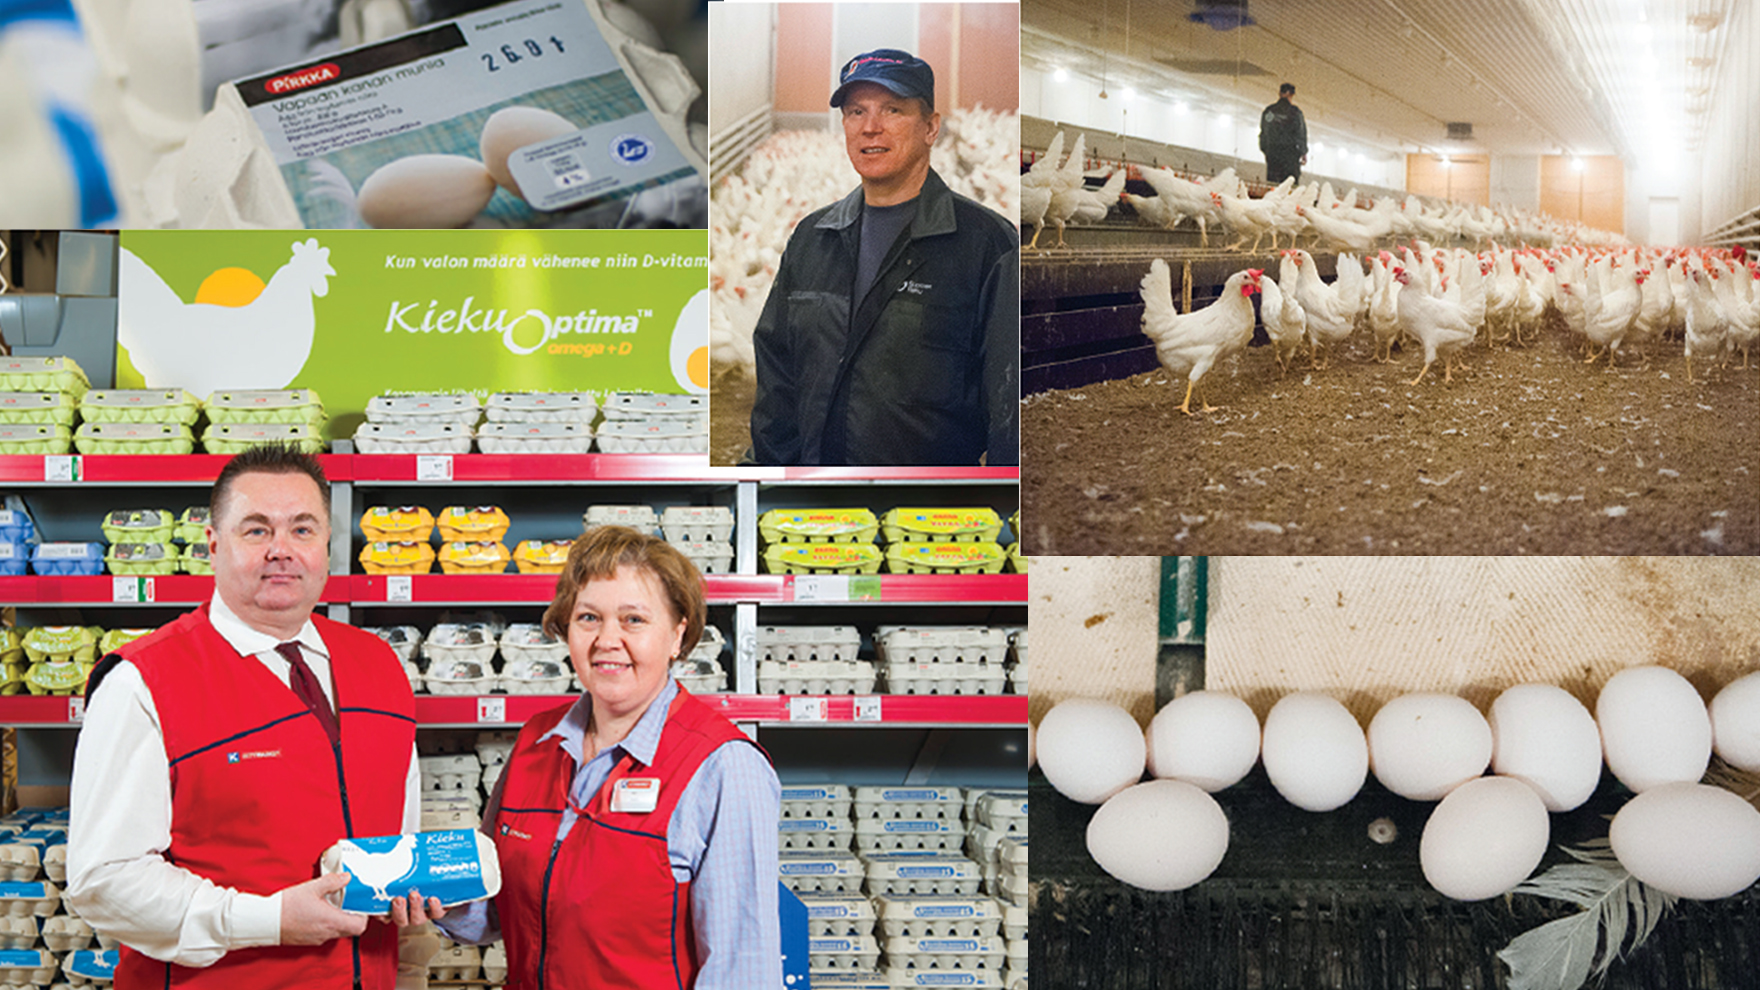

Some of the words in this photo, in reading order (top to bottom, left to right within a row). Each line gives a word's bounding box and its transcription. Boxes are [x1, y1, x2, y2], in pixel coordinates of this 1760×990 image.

[272, 88, 339, 113] Vapaan
[342, 75, 393, 96] kanan
[395, 57, 445, 80] munia
[384, 254, 416, 269] Kun
[422, 254, 469, 269] valon
[472, 253, 527, 269] määrä
[532, 253, 601, 269] vähenee
[605, 253, 638, 269] niin
[384, 295, 508, 334] Kieku
[547, 342, 605, 358] omega
